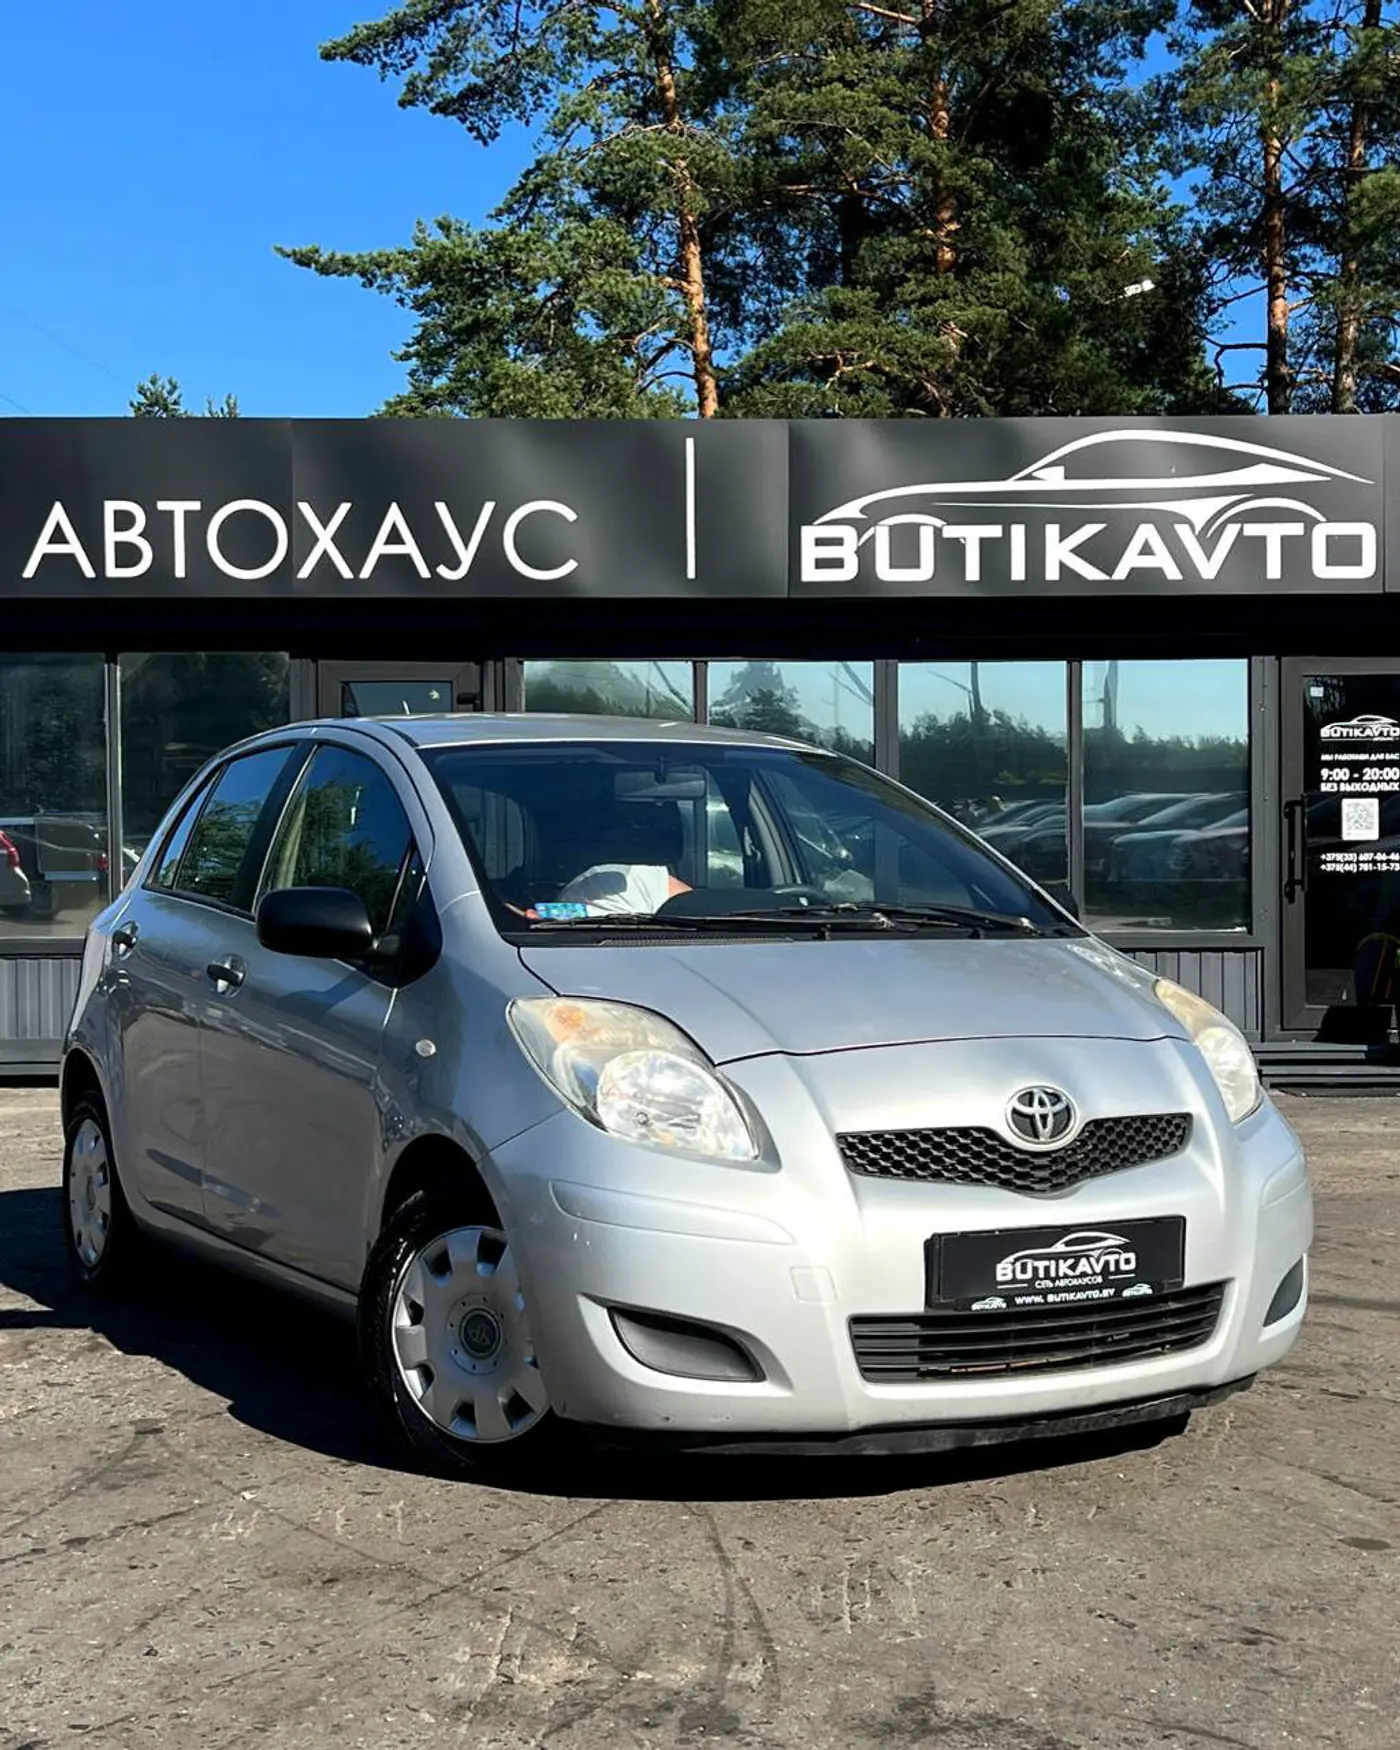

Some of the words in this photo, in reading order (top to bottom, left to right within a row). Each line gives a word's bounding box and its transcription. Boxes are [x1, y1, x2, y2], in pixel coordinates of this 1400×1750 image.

[21, 499, 579, 581] АВТОХАУС
[800, 522, 1377, 582] BUTIKAVTO
[1320, 727, 1400, 738] BUTIKAVTO
[1320, 767, 1350, 781] 9:00
[1362, 767, 1400, 781] 20:00
[1320, 782, 1338, 792] БЕЗ
[1339, 782, 1400, 792] ВЫХОДНЫХ
[995, 1252, 1137, 1281] BUTIKAVTO
[1034, 1280, 1054, 1289] СЕТЬ
